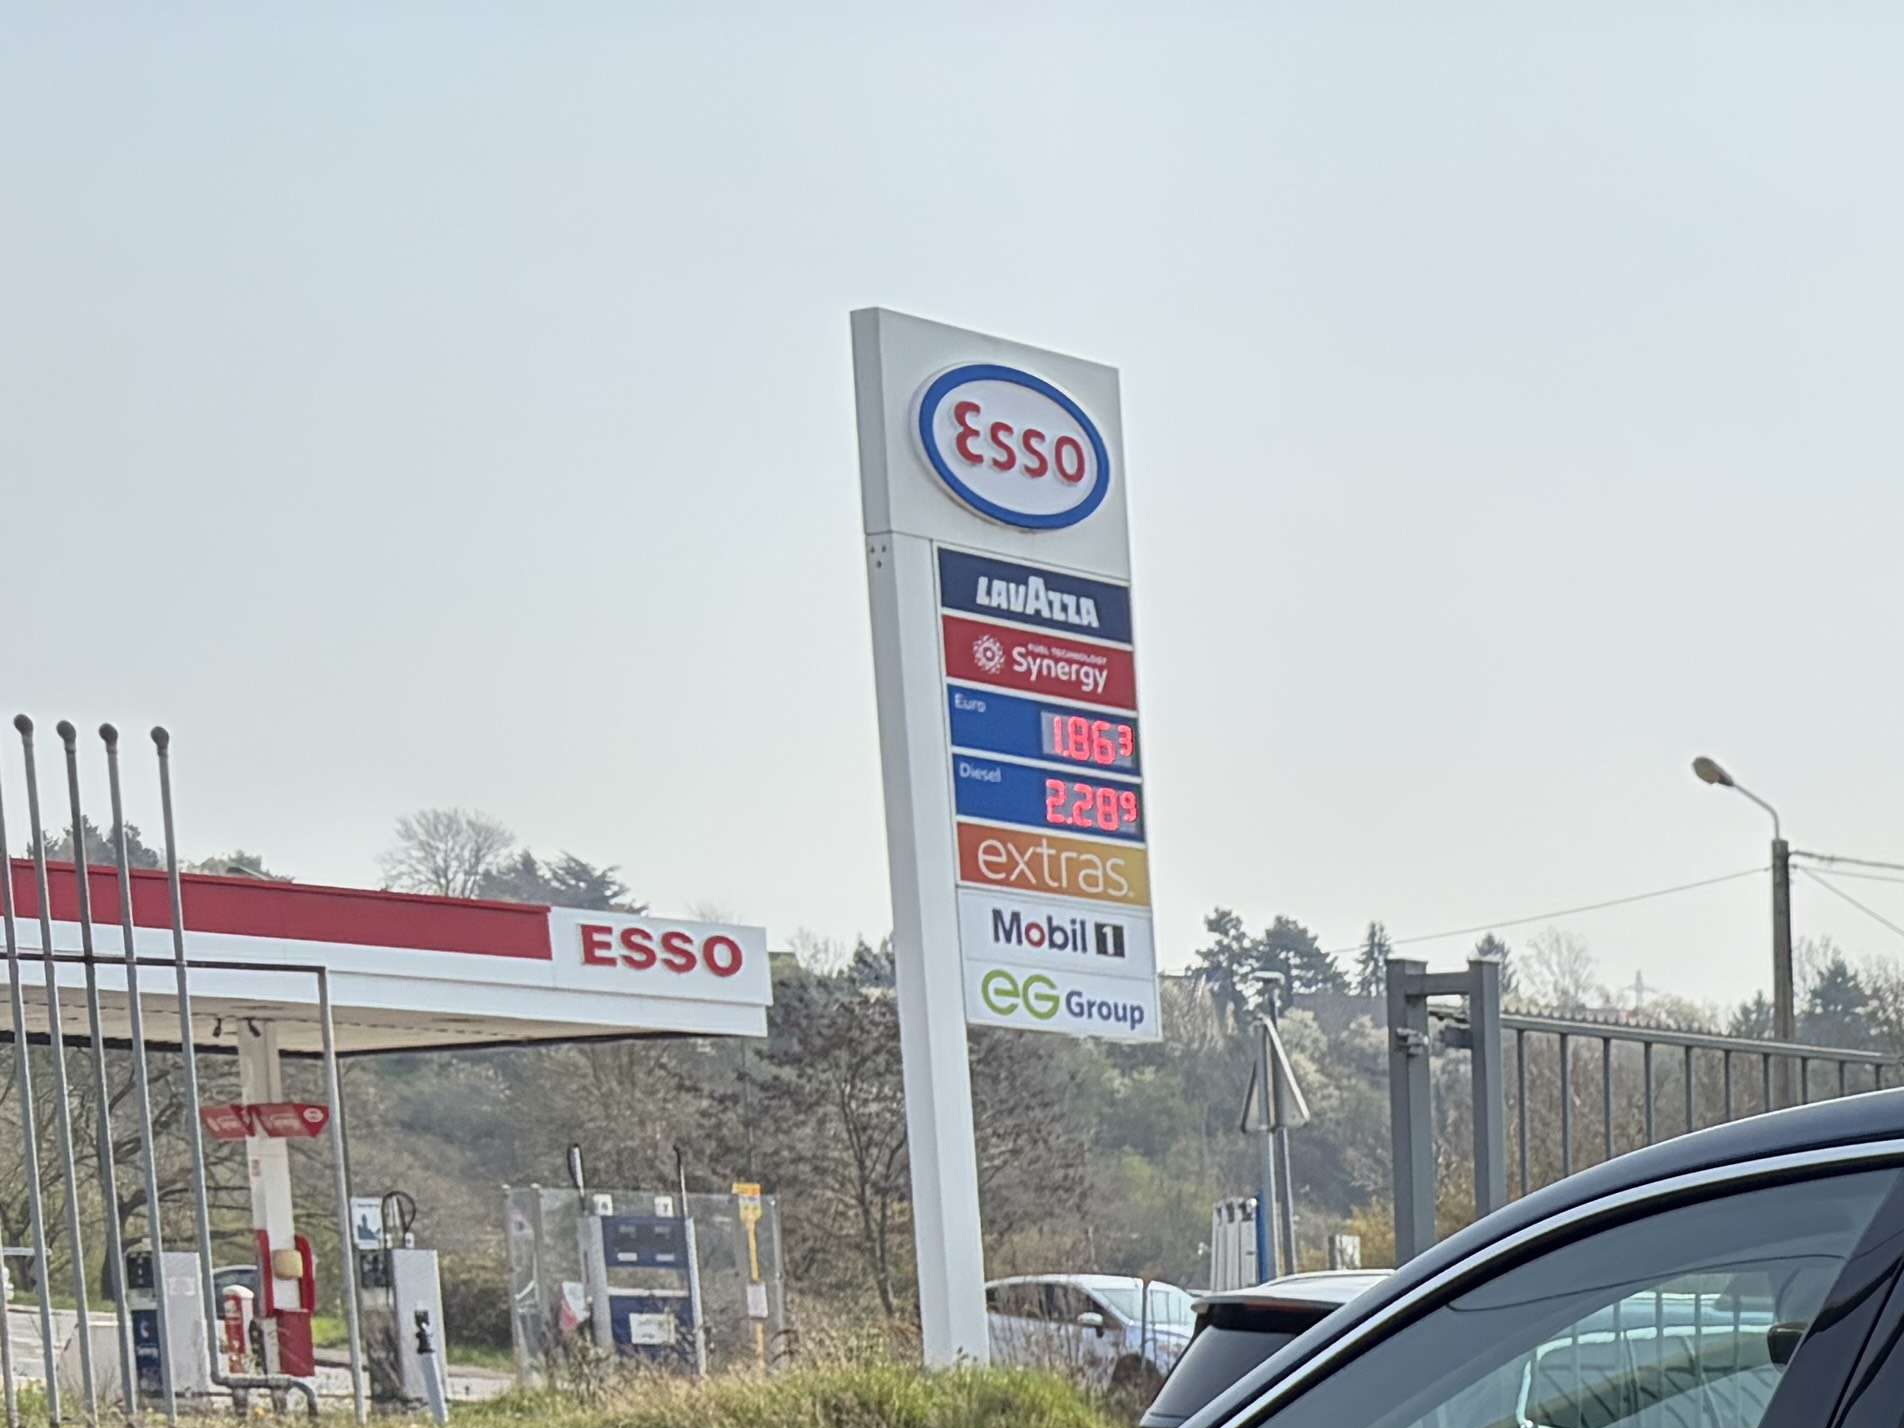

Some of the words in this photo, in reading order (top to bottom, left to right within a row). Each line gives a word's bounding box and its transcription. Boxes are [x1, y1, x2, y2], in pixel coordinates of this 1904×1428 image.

[975, 575, 1100, 628] LAVAZZA
[1012, 646, 1108, 694] Synergy
[954, 693, 987, 712] Euro
[959, 762, 1002, 783] Diesel
[976, 838, 1130, 898] extras
[579, 923, 744, 978] ESSO
[991, 907, 1088, 955] Mobil
[1098, 923, 1119, 957] 1
[1064, 990, 1145, 1031] Group
